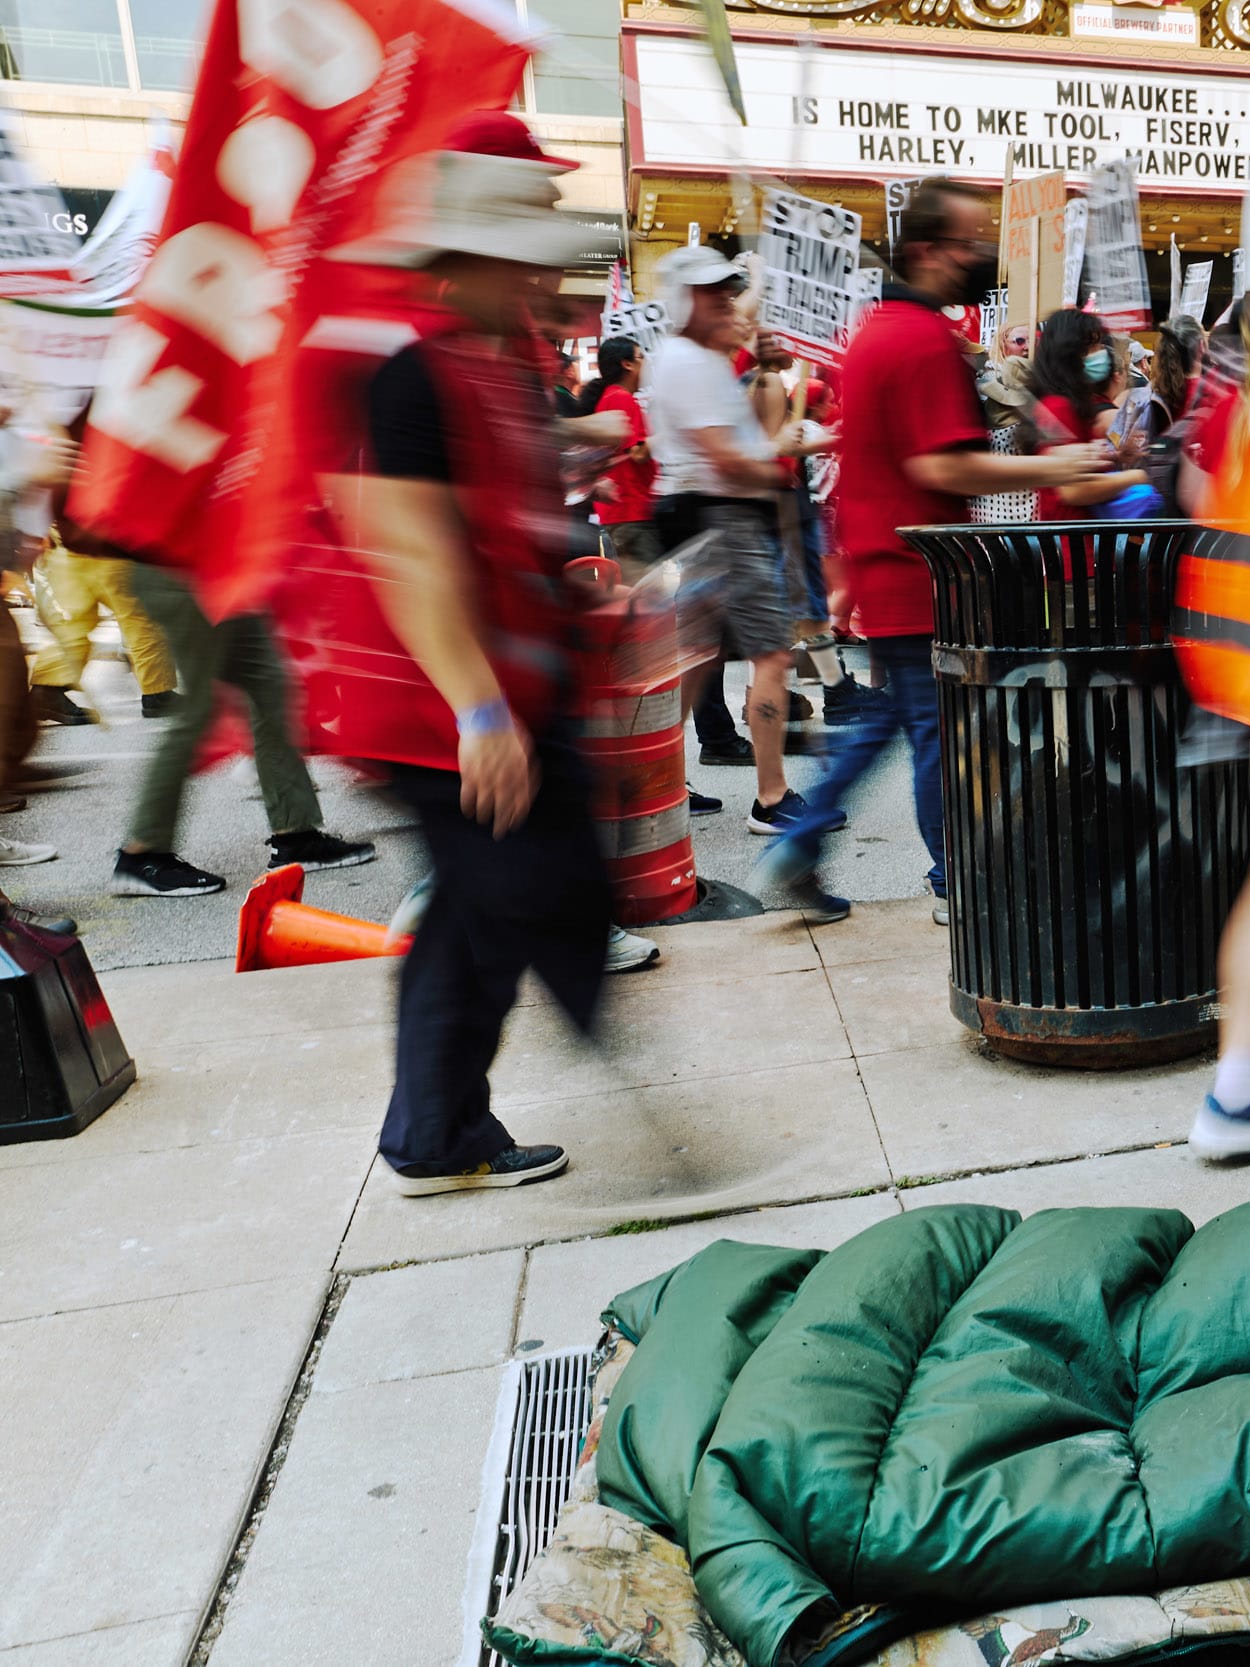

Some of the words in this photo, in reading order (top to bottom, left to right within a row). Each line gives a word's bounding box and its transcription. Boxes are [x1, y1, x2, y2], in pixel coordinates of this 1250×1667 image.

[1076, 15, 1112, 28] OFFICIAL
[1114, 18, 1154, 32] BREWERY
[1156, 21, 1194, 35] PARTNER
[792, 96, 819, 125] IS
[839, 101, 910, 130] HOME
[926, 106, 961, 133] TO
[977, 108, 1028, 136] MKE
[1044, 113, 1120, 142] TOOL,
[1146, 118, 1240, 148] FISERV,
[859, 134, 975, 166] HARLEY,
[1013, 143, 1097, 172] MILLER
